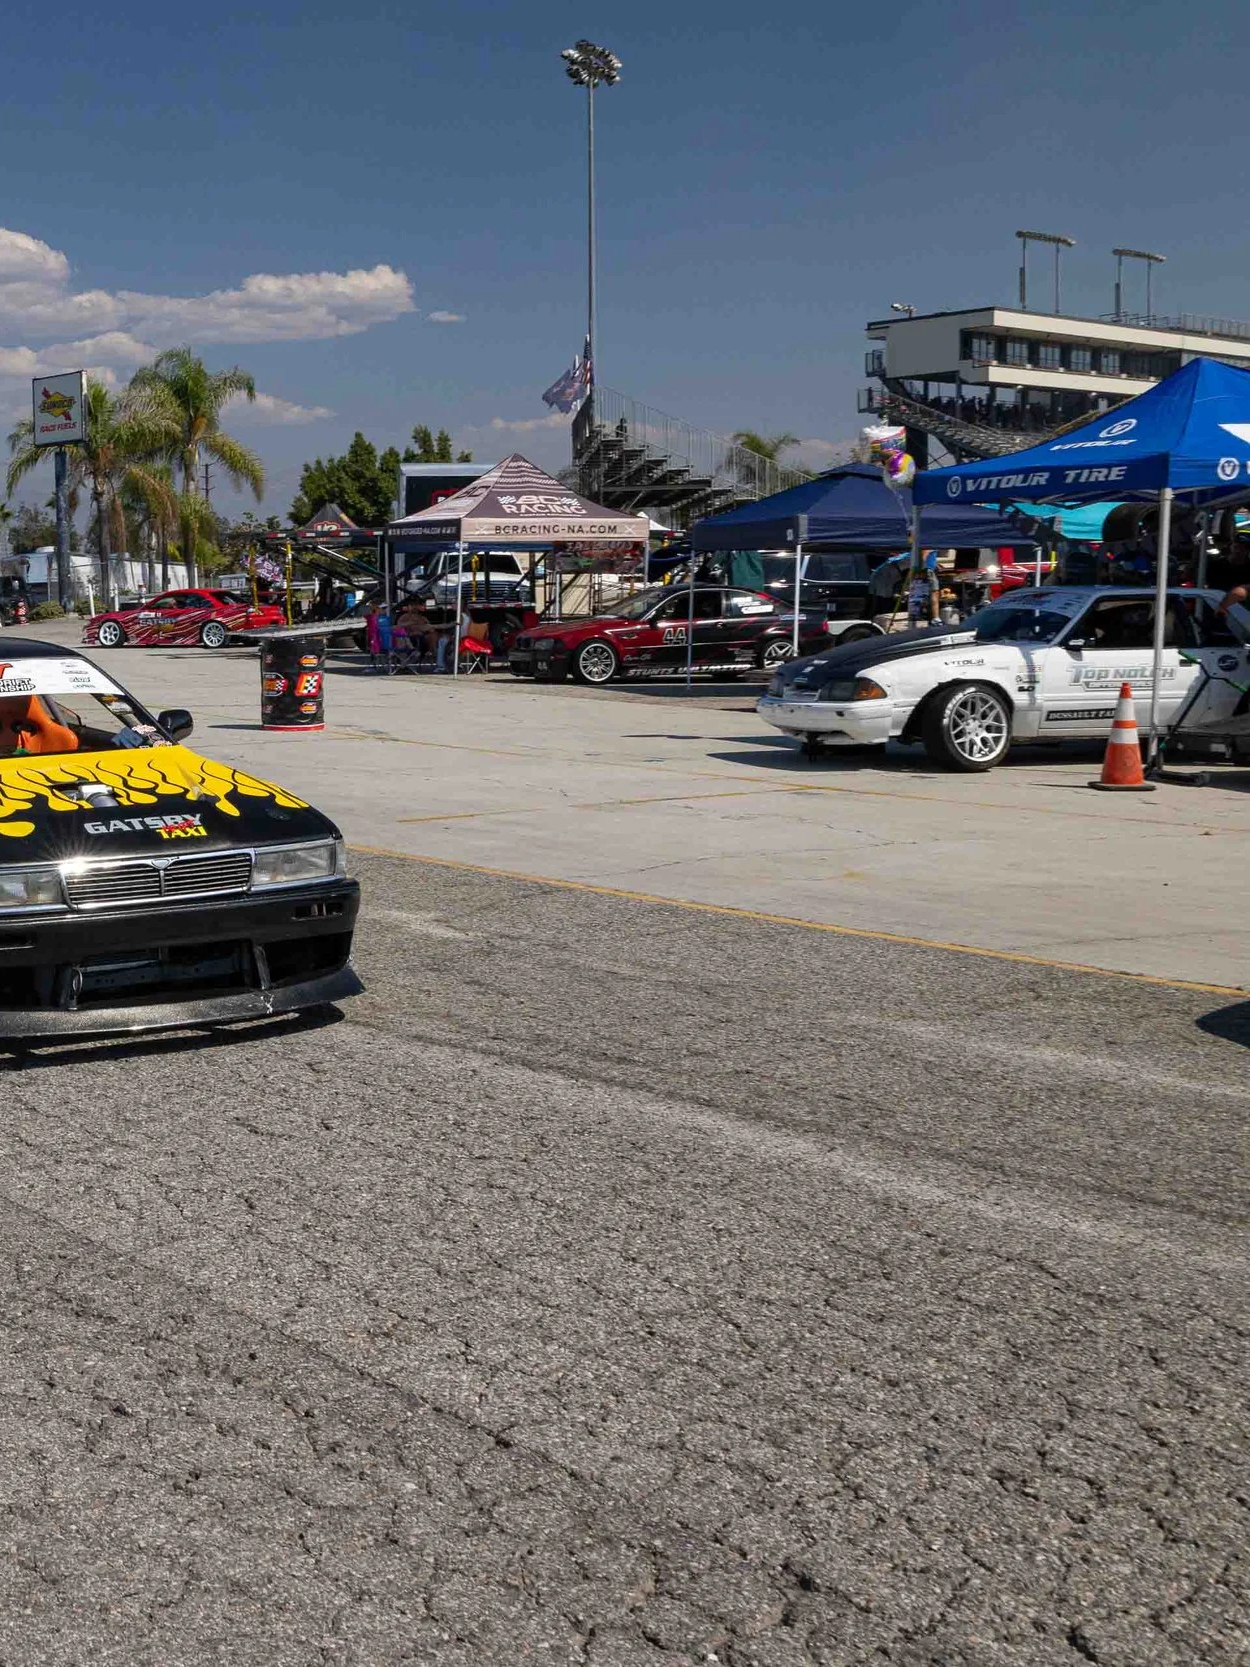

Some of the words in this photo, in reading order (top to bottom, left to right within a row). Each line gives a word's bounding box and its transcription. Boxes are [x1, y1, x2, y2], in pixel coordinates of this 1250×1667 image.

[965, 471, 1050, 491] VITOUR
[1063, 466, 1128, 485] TIRE
[501, 504, 587, 514] RACING
[494, 524, 618, 535] BCRACING-NA.COM
[662, 627, 687, 647] 44
[627, 668, 675, 677] STUNTS
[84, 813, 202, 834] GATSBY
[156, 826, 208, 839] TAXI
